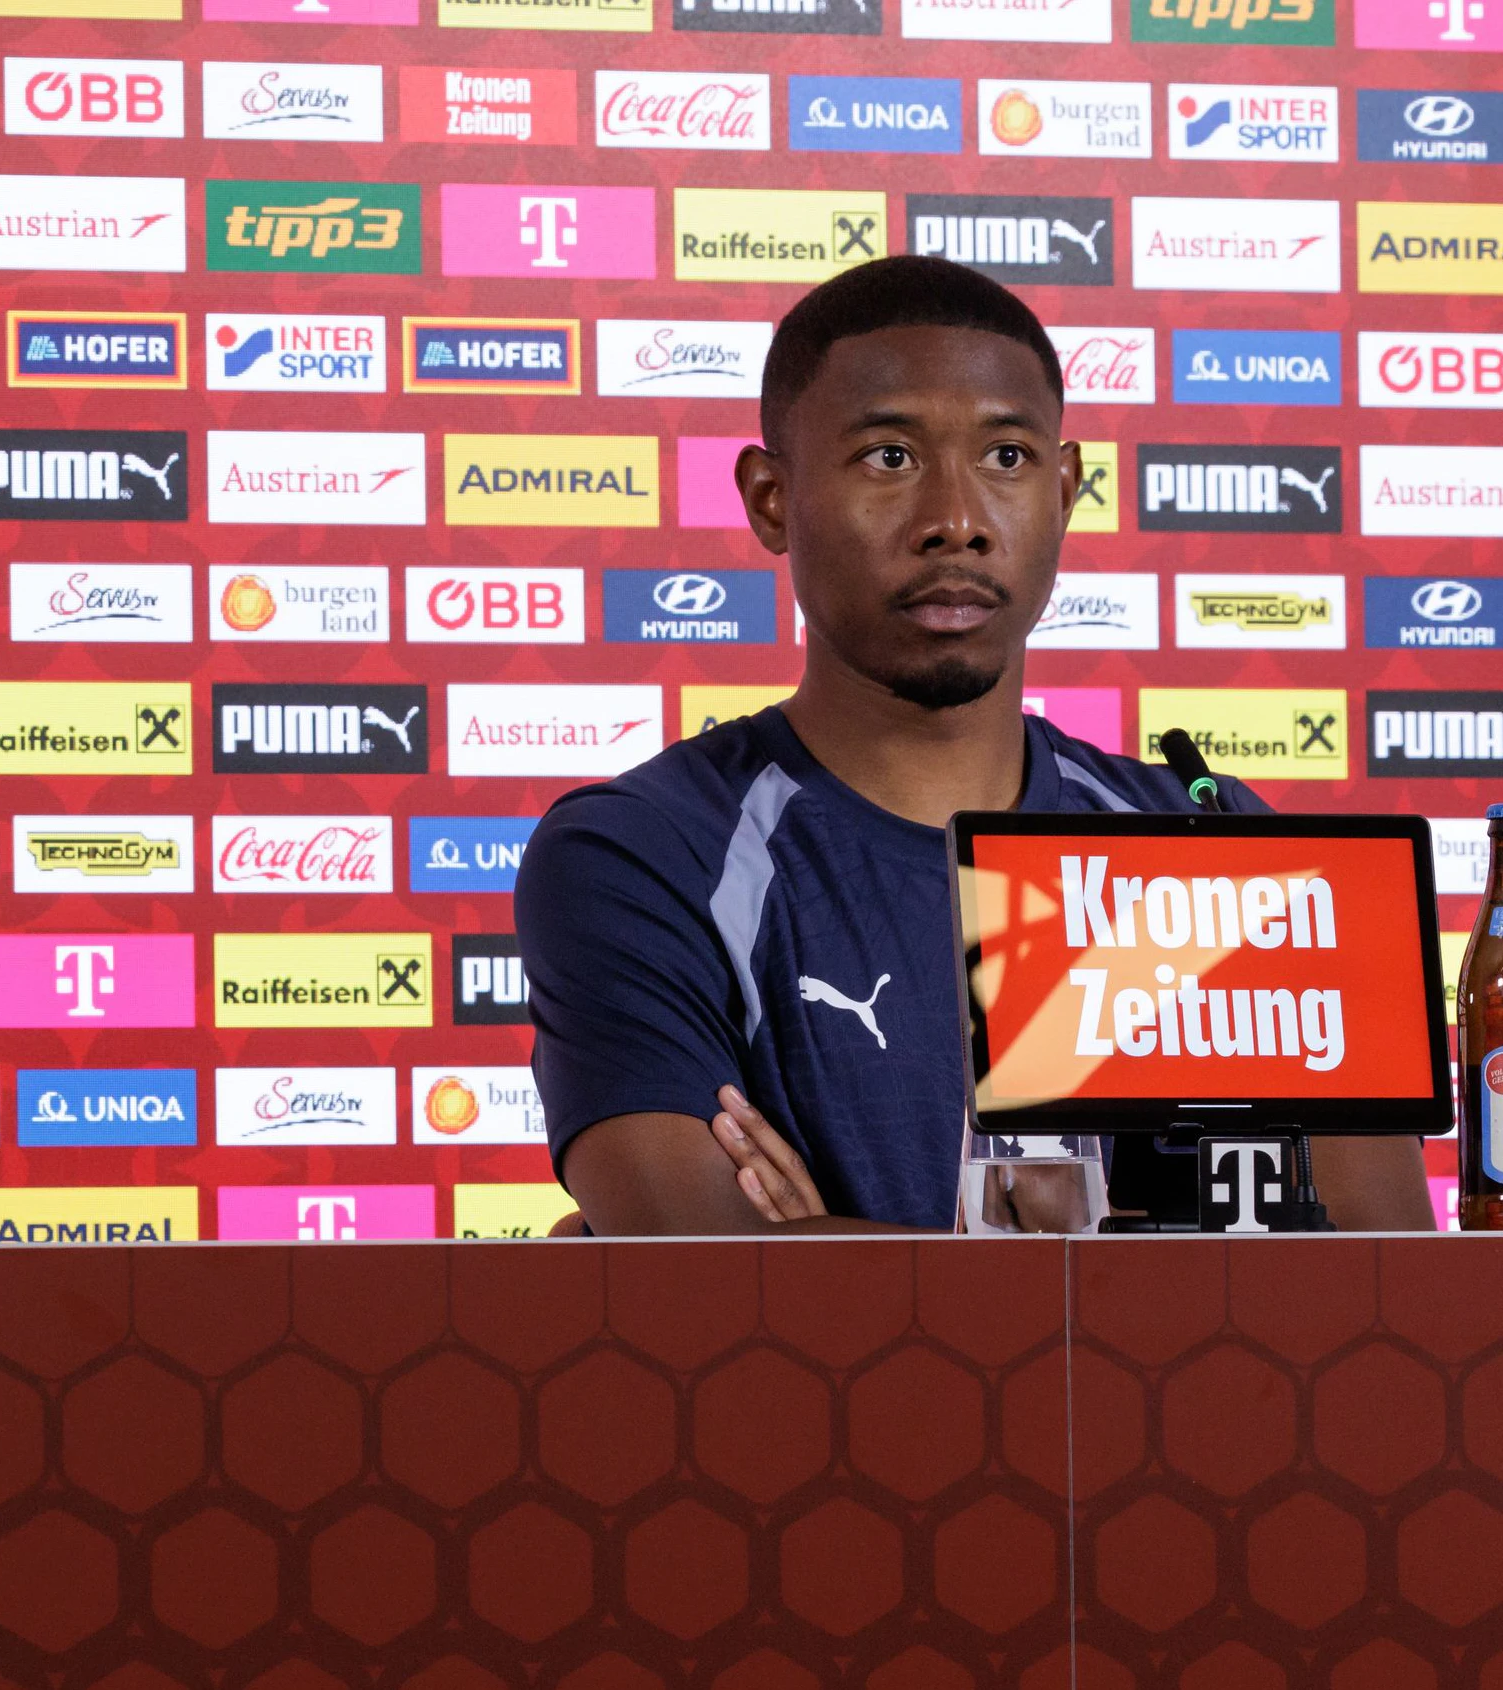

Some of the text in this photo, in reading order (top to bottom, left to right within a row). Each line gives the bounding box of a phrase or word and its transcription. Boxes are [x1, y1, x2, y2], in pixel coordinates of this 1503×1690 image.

[25, 72, 163, 123] ÖBB
[446, 72, 531, 101] Kronen
[446, 105, 531, 140] Zeitung
[602, 83, 759, 138] Coca-Cola
[852, 103, 949, 130] UNIQA
[1051, 96, 1140, 130] burgen
[1241, 98, 1326, 121] INTER
[1087, 124, 1140, 147] land
[1239, 125, 1326, 149] SPORT
[1393, 141, 1487, 159] HYUNDAI
[226, 198, 403, 257] tipp3
[520, 197, 577, 267] T
[916, 216, 1048, 263] PUMA
[683, 232, 825, 260] Raiffeisen
[1147, 230, 1277, 259] Austrian
[1371, 232, 1503, 261] ADMIR
[65, 335, 168, 363] HOFER
[281, 326, 372, 352] INTER
[279, 354, 373, 378] SPORT
[459, 341, 562, 368] HOFER
[1056, 335, 1140, 391] -Cola
[1235, 356, 1330, 382] UNIQA
[1379, 345, 1503, 394] ÖBB
[222, 463, 360, 493] Austrian
[458, 465, 648, 496] ADMIRAL
[1146, 464, 1279, 512] PUMA
[1374, 477, 1503, 506] Austrian
[285, 580, 376, 612] burgen
[427, 579, 564, 630] ÖBB
[322, 609, 376, 632] land
[641, 621, 738, 639] HYUNDAI
[1401, 627, 1495, 645] HYUNDAI
[222, 705, 359, 753] PUMA
[462, 716, 598, 745] Austrian
[1374, 711, 1503, 759] PUMA
[1148, 732, 1286, 758] Rffeisen
[219, 827, 380, 881] Coca-Cola
[1061, 856, 1336, 949] Kronen
[56, 946, 114, 1017] T
[223, 978, 369, 1004] Raiffeisen
[462, 956, 528, 1003] PU
[1070, 964, 1344, 1070] Zeitung
[84, 1096, 185, 1121] UNIQA
[488, 1081, 543, 1112] burg
